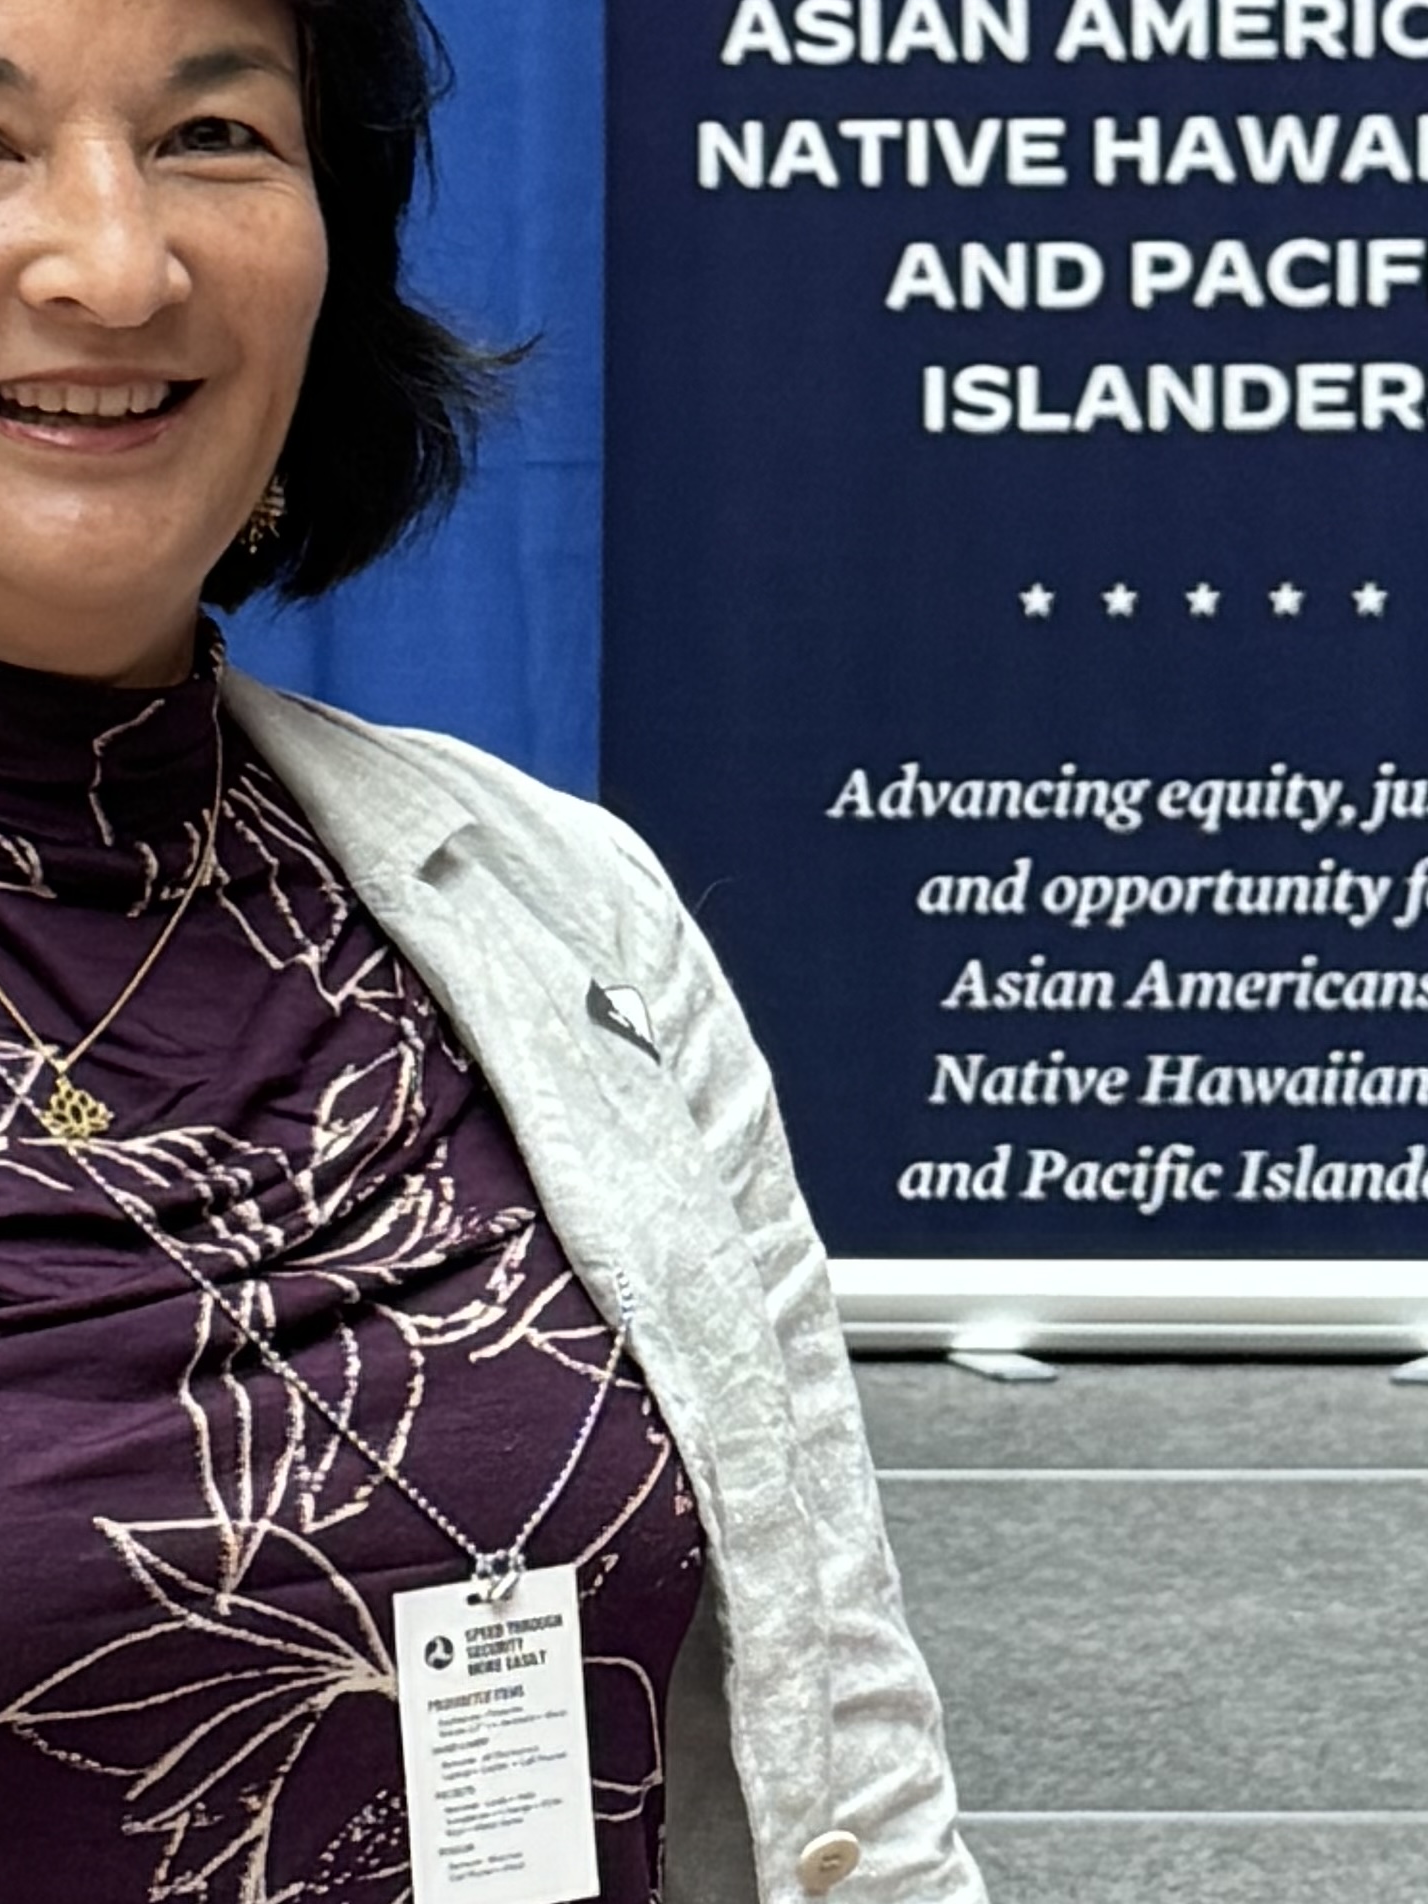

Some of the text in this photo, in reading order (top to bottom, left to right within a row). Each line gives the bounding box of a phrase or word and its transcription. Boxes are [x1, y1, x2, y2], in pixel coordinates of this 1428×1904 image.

[697, 116, 1069, 190] NATIVE
[884, 240, 1105, 312] AND
[825, 761, 1153, 833] Advancing
[1156, 763, 1359, 834] equity,
[915, 856, 1033, 915] and
[1040, 856, 1393, 930] opportunity
[939, 953, 1116, 1011] Asian
[927, 1048, 1131, 1106] Native
[896, 1142, 1013, 1203] and
[1018, 1142, 1225, 1216] Pacific
[466, 1637, 524, 1659] SECURITY
